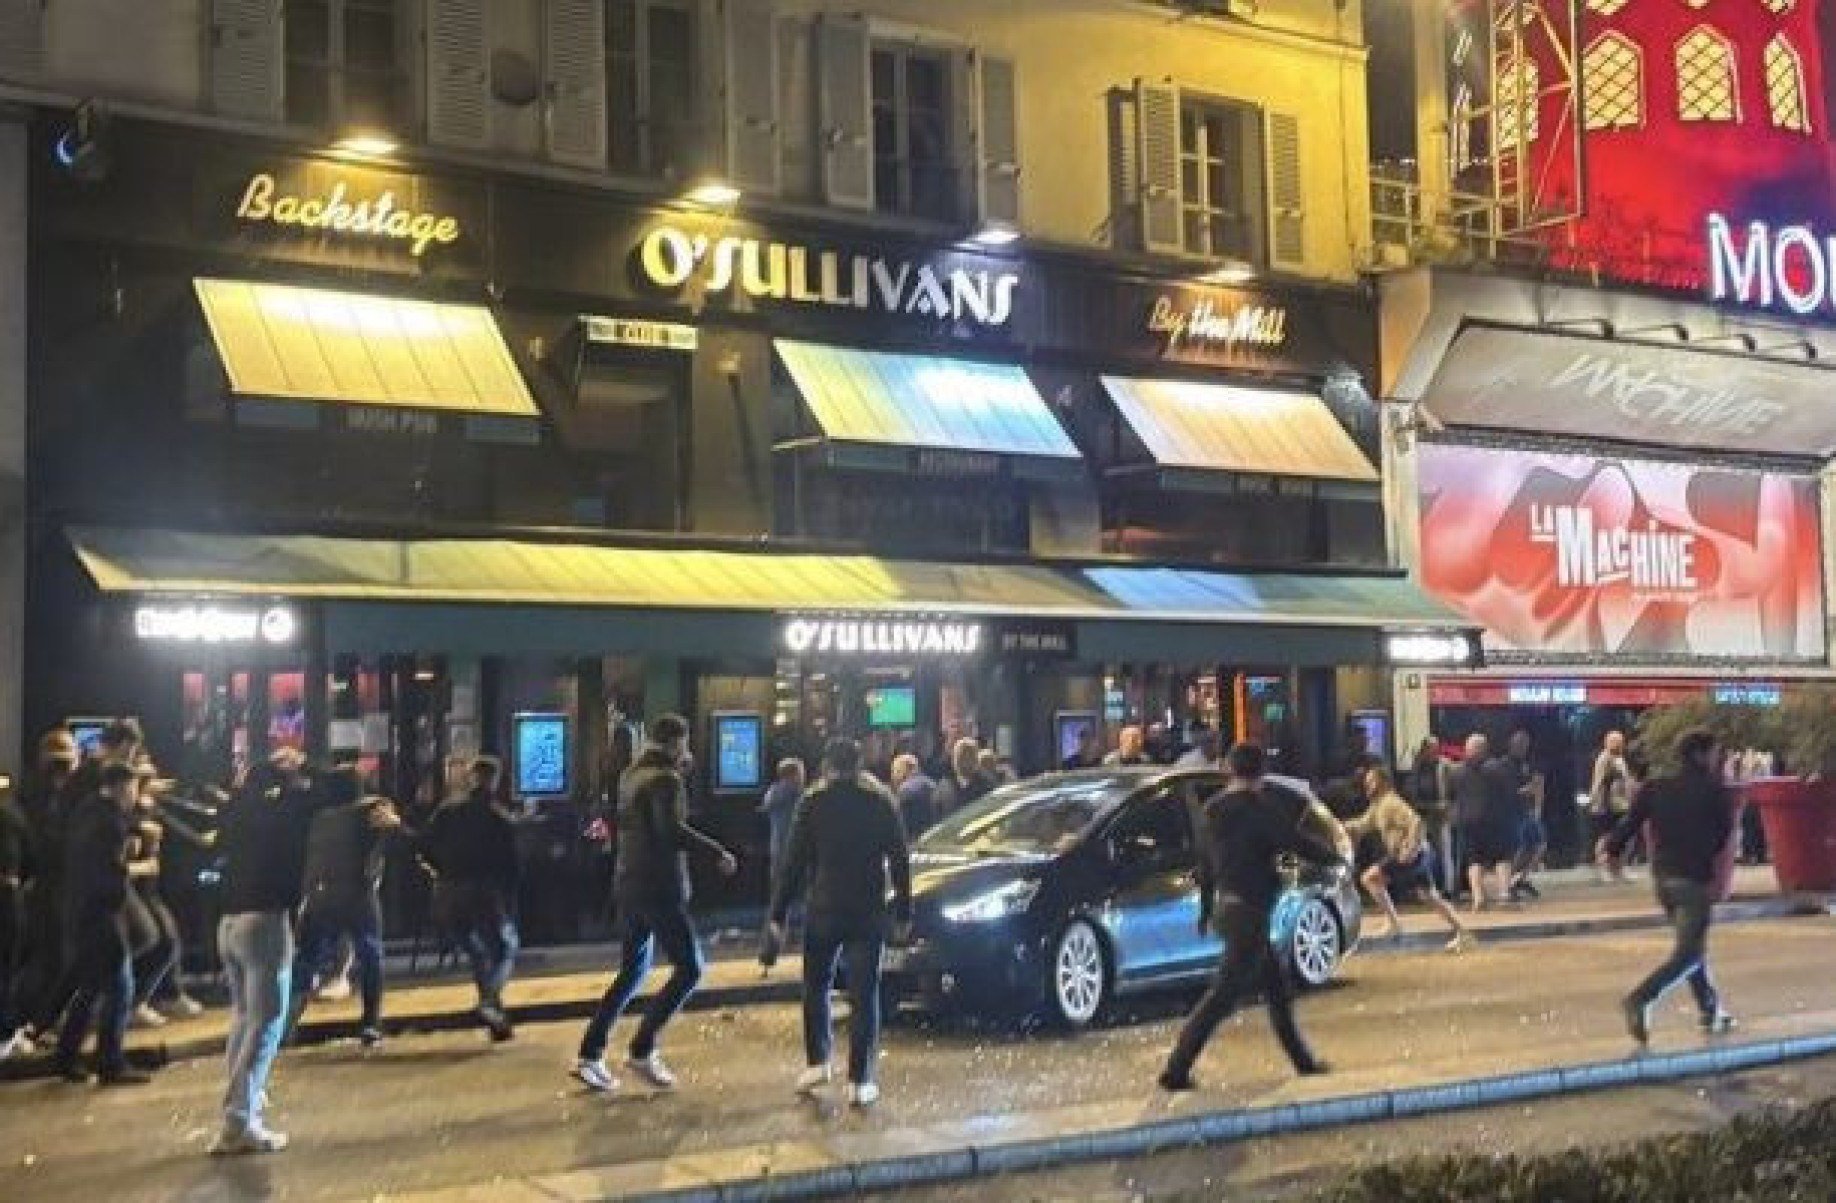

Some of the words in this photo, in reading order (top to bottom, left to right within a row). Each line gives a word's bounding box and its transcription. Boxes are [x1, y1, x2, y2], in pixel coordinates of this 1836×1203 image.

[235, 173, 459, 256] Backstage
[642, 227, 1018, 326] O'SULLIVANS
[1708, 211, 1836, 314] MO
[784, 619, 982, 653] O'SULLIVANS
